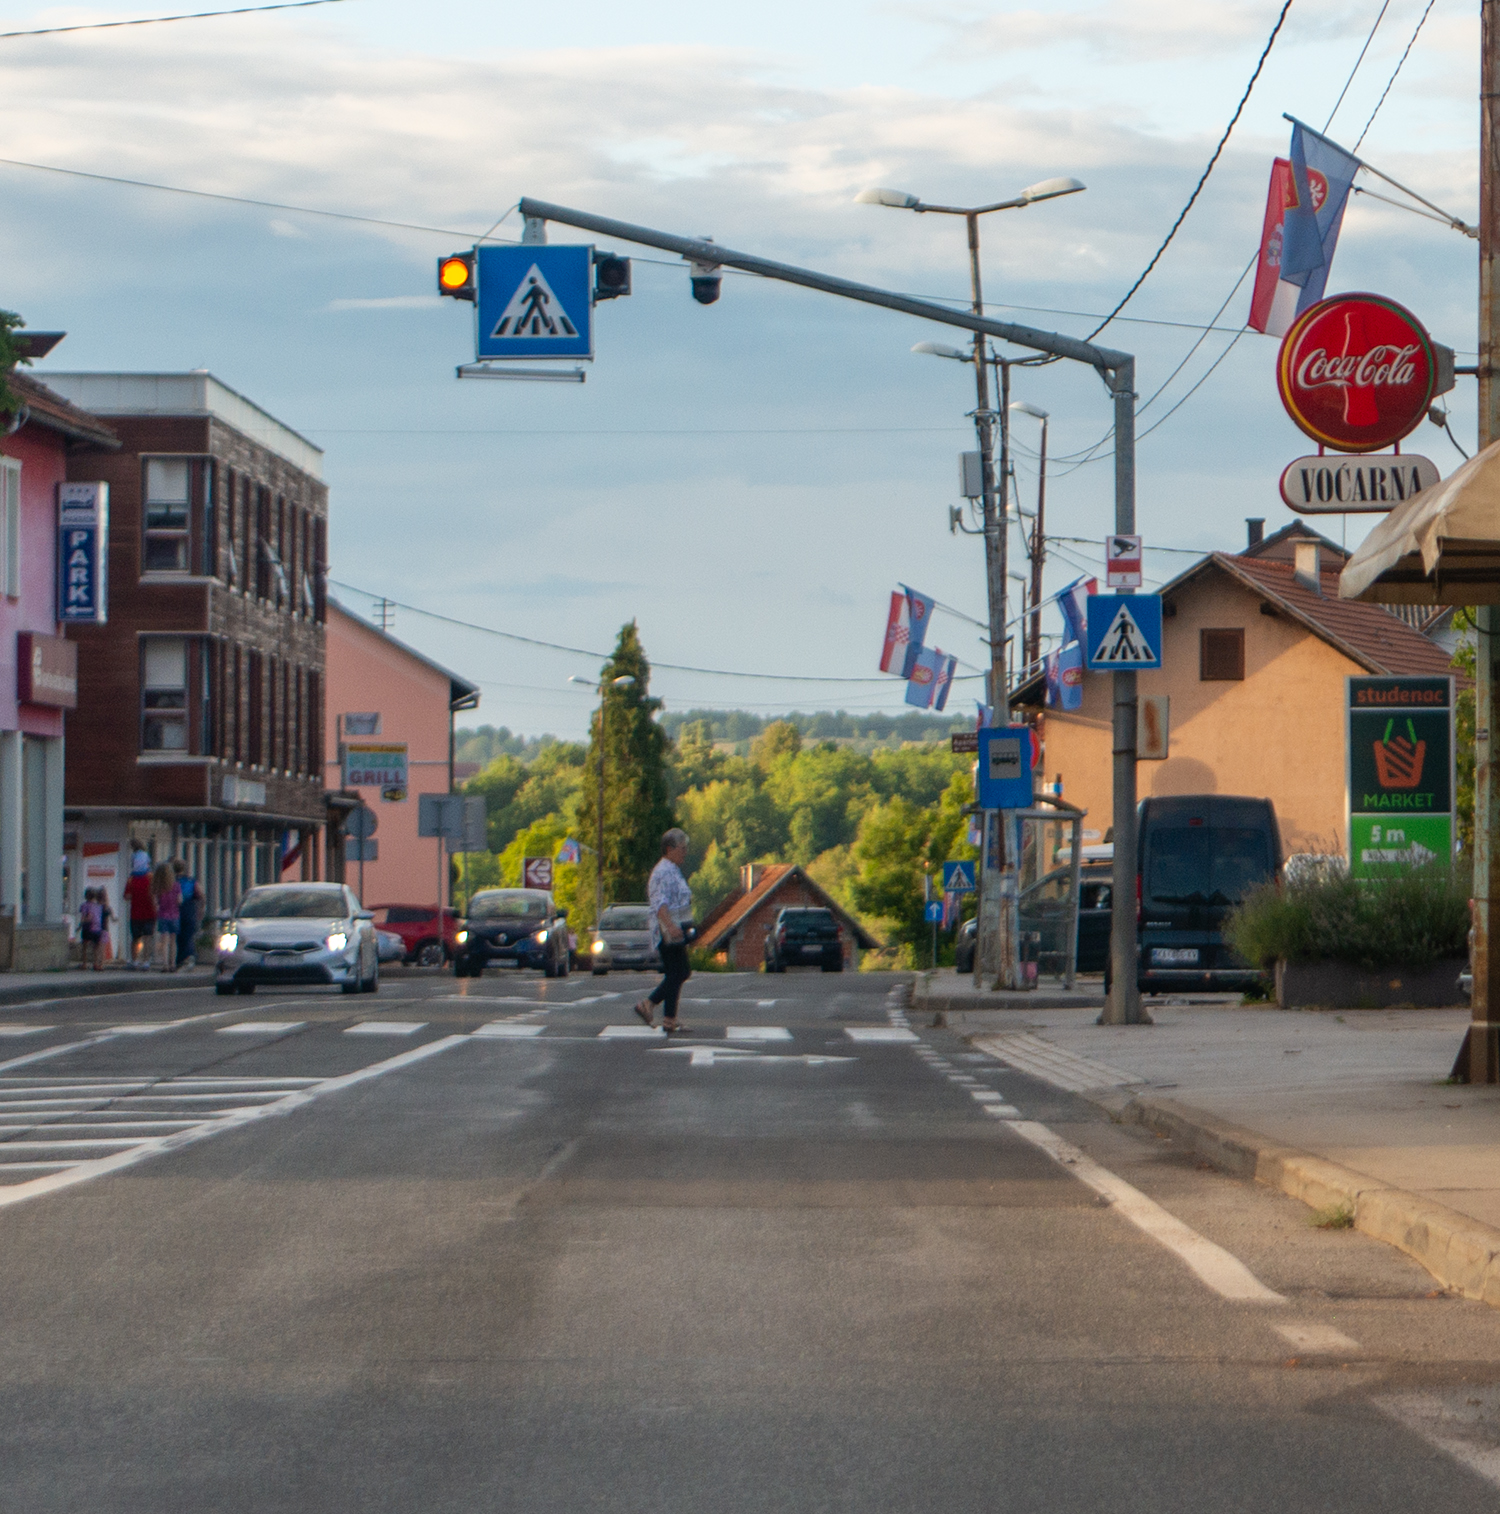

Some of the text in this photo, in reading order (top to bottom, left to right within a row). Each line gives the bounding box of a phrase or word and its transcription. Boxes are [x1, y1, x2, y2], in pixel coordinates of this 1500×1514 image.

[1297, 343, 1421, 389] Coca-Cola
[1300, 462, 1422, 503] VOĆARNA
[68, 530, 90, 604] PARK
[1356, 686, 1444, 703] studenac
[349, 770, 405, 784] GRILL
[1363, 793, 1435, 807] MARKET
[1370, 825, 1406, 842] 5 m
